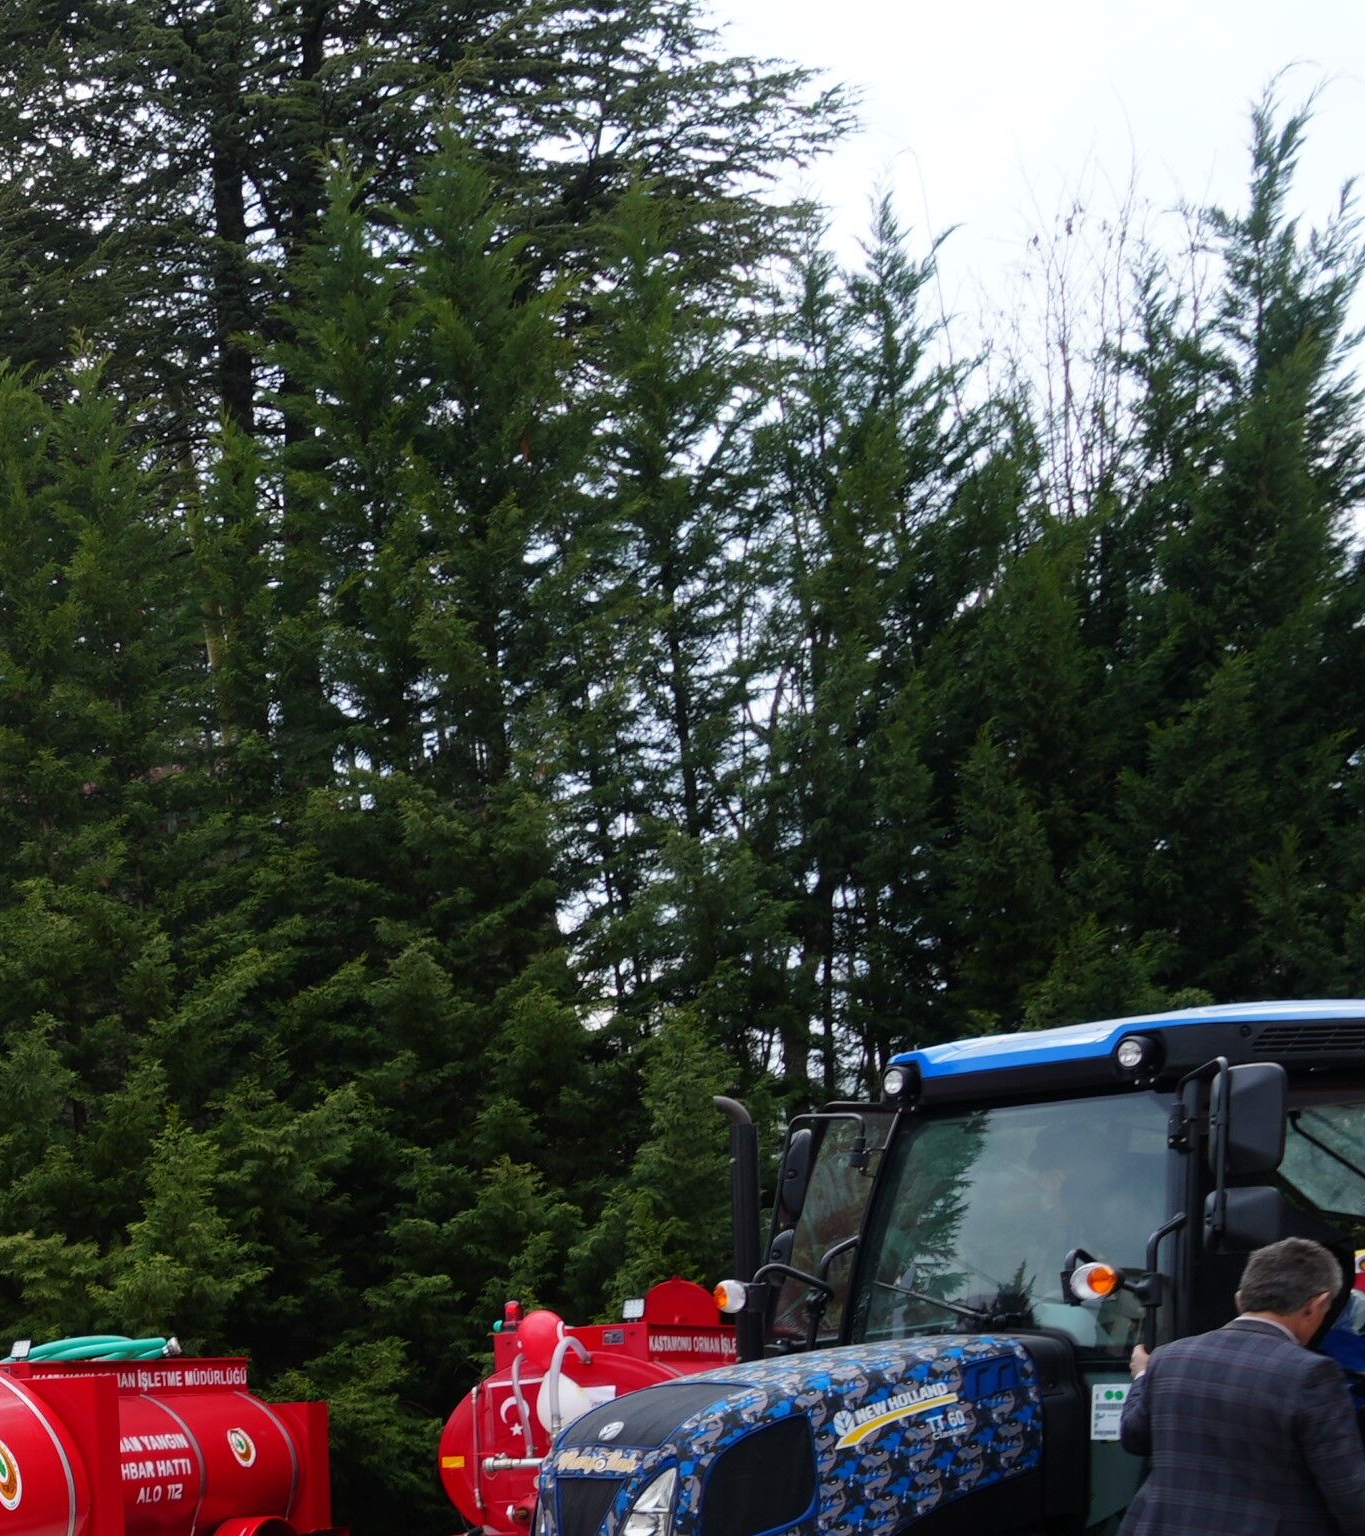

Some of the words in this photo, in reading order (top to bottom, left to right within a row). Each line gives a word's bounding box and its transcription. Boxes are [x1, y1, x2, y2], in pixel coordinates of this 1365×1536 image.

[648, 1335, 691, 1352] KASTAMONU
[693, 1335, 719, 1353] ORMAN
[721, 1333, 736, 1355] İŞLE
[137, 1369, 183, 1392] İŞLETME
[185, 1367, 247, 1386] MÜDÜRLÜĞÜ
[854, 1401, 888, 1424] NEW
[887, 1382, 948, 1411] HOLLAND
[925, 1414, 944, 1432] TT
[947, 1409, 966, 1427] 60
[143, 1433, 190, 1450] YANGIN
[121, 1461, 156, 1481] HBAR
[156, 1458, 192, 1477] HATTI
[136, 1486, 162, 1505] ALO
[167, 1483, 183, 1500] 112
